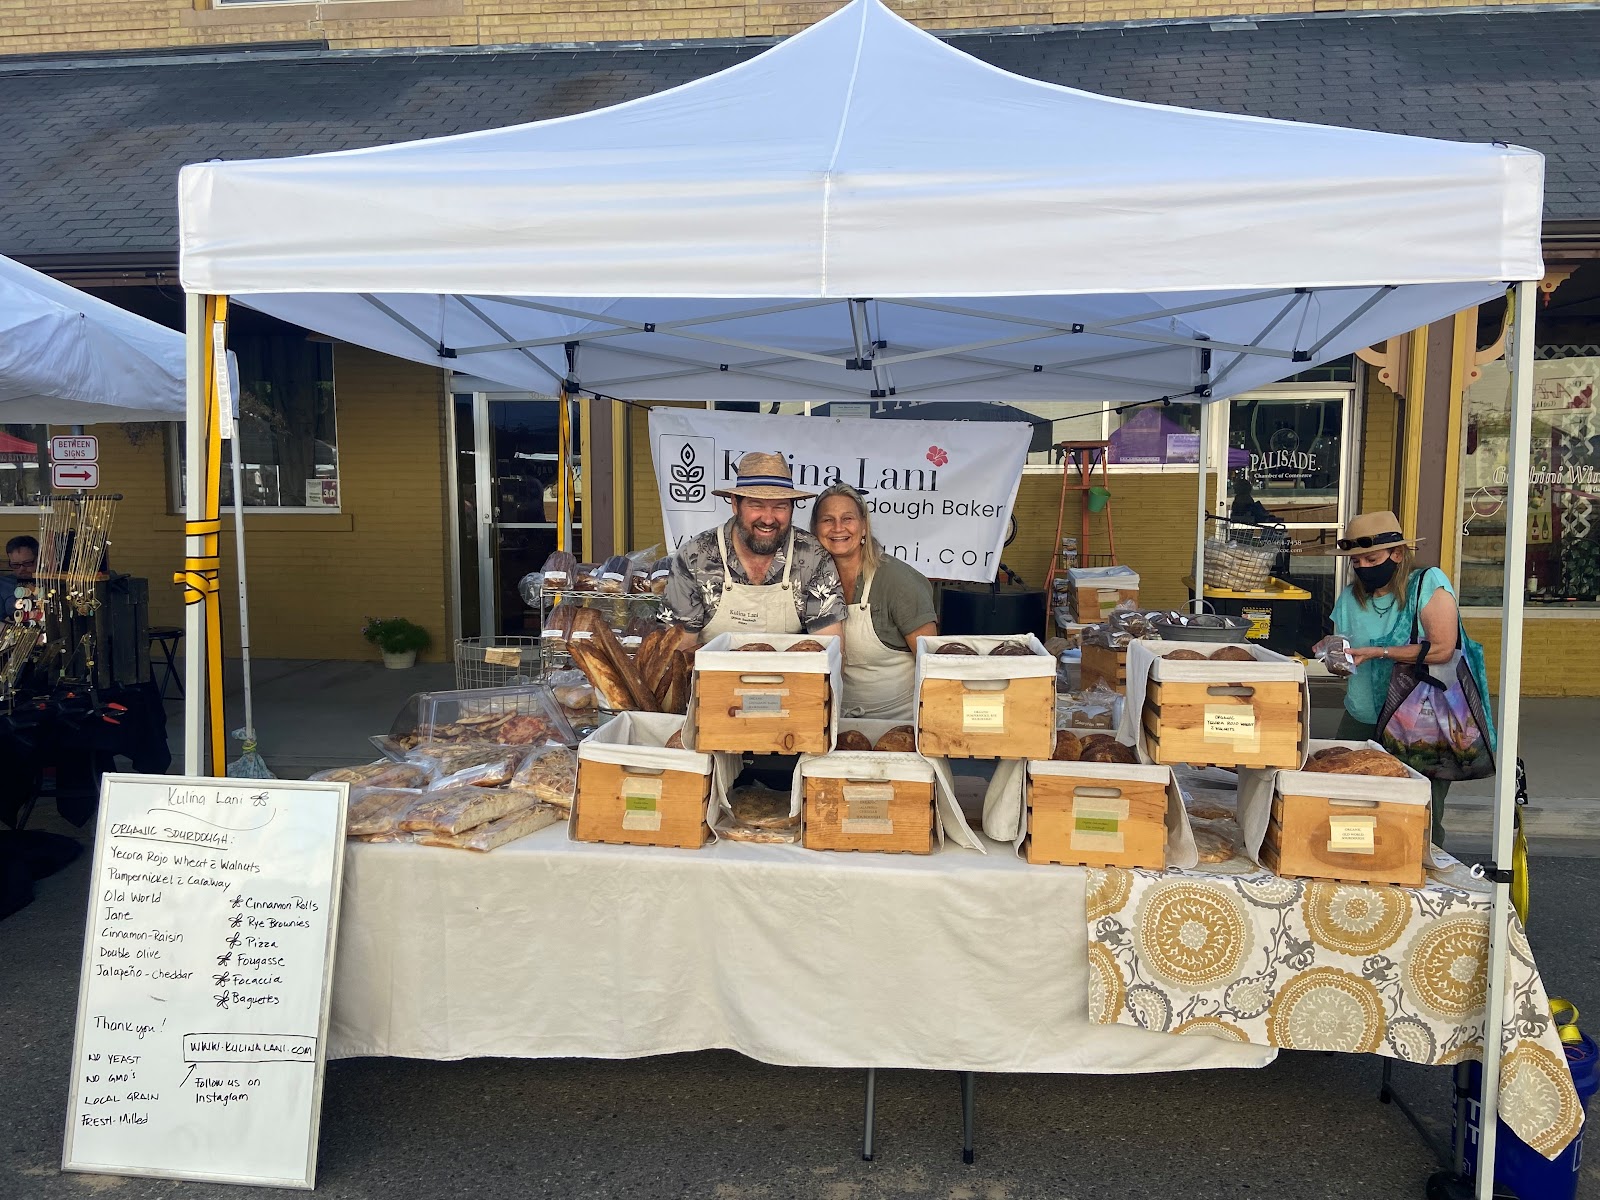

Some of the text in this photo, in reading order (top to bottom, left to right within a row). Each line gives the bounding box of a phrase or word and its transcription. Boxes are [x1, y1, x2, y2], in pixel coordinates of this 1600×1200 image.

[58, 440, 91, 448] BETWEEN
[1250, 449, 1317, 472] PALISADE
[721, 449, 939, 492] Kina Lani
[323, 488, 336, 498] 30
[866, 497, 1007, 520] dough Baker
[168, 787, 243, 806] Kulina Lani
[110, 823, 157, 836] ORGANIC
[110, 845, 143, 861] Yecora
[147, 851, 169, 867] Rojo
[174, 855, 208, 869] Wheat
[220, 858, 261, 874] Walnuts
[108, 867, 174, 887] Pumpernickel
[187, 875, 231, 893] Caraway
[103, 889, 162, 904] Old World
[245, 895, 319, 912] Cinnamon Rolls
[105, 906, 134, 921] Jane
[247, 915, 310, 930] Rye Brownies
[101, 926, 184, 943] Cinnamon-Raisin
[245, 936, 279, 949] Pizza
[100, 946, 131, 959] Double
[237, 953, 286, 971] Fougasse
[232, 973, 283, 986] Focaccia
[94, 1015, 133, 1032] Thank
[88, 1053, 142, 1065] NO YEAST
[86, 1074, 100, 1083] NO
[194, 1077, 261, 1089] Follow us on
[84, 1091, 159, 1106] LOCAL GRAIN
[195, 1091, 249, 1107] Instagram
